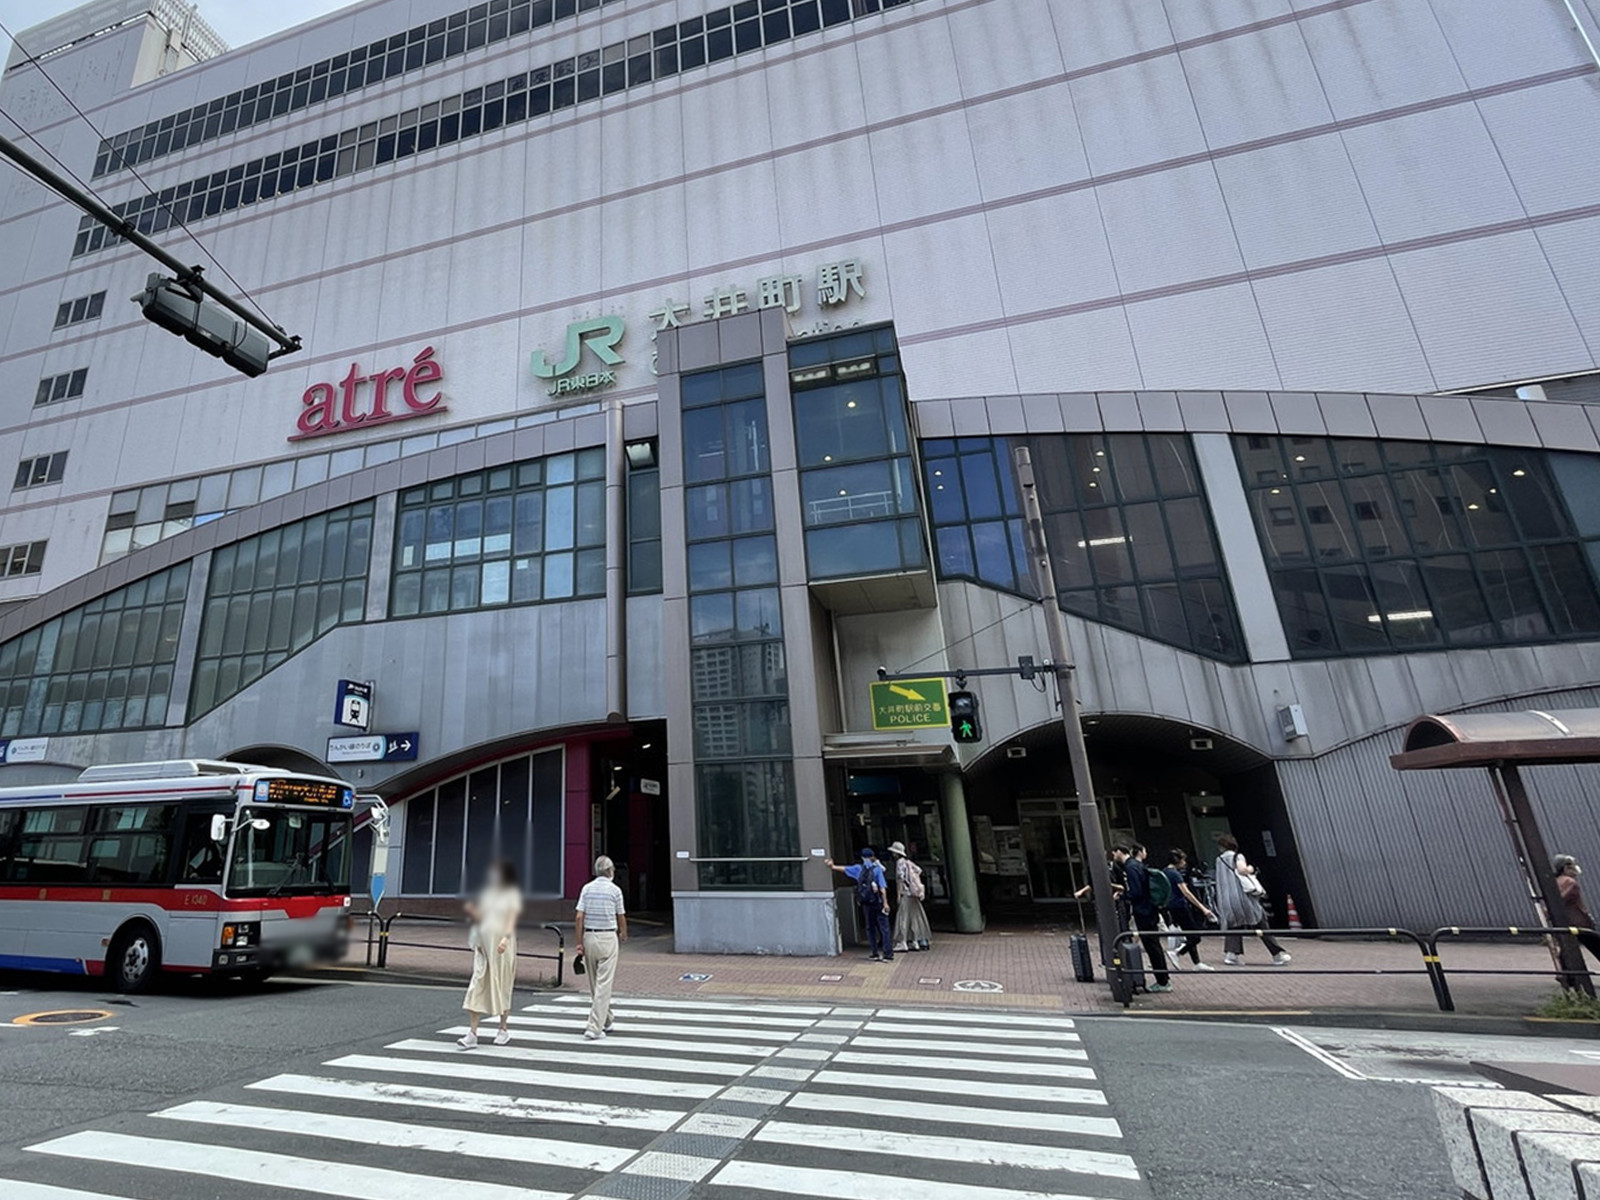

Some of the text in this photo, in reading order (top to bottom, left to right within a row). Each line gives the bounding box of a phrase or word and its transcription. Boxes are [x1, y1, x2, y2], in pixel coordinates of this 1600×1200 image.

[648, 257, 867, 329] 大井町駅
[531, 315, 625, 379] JR
[297, 345, 443, 434] atré
[546, 370, 617, 396] JR東日本
[890, 713, 931, 724] POLICE
